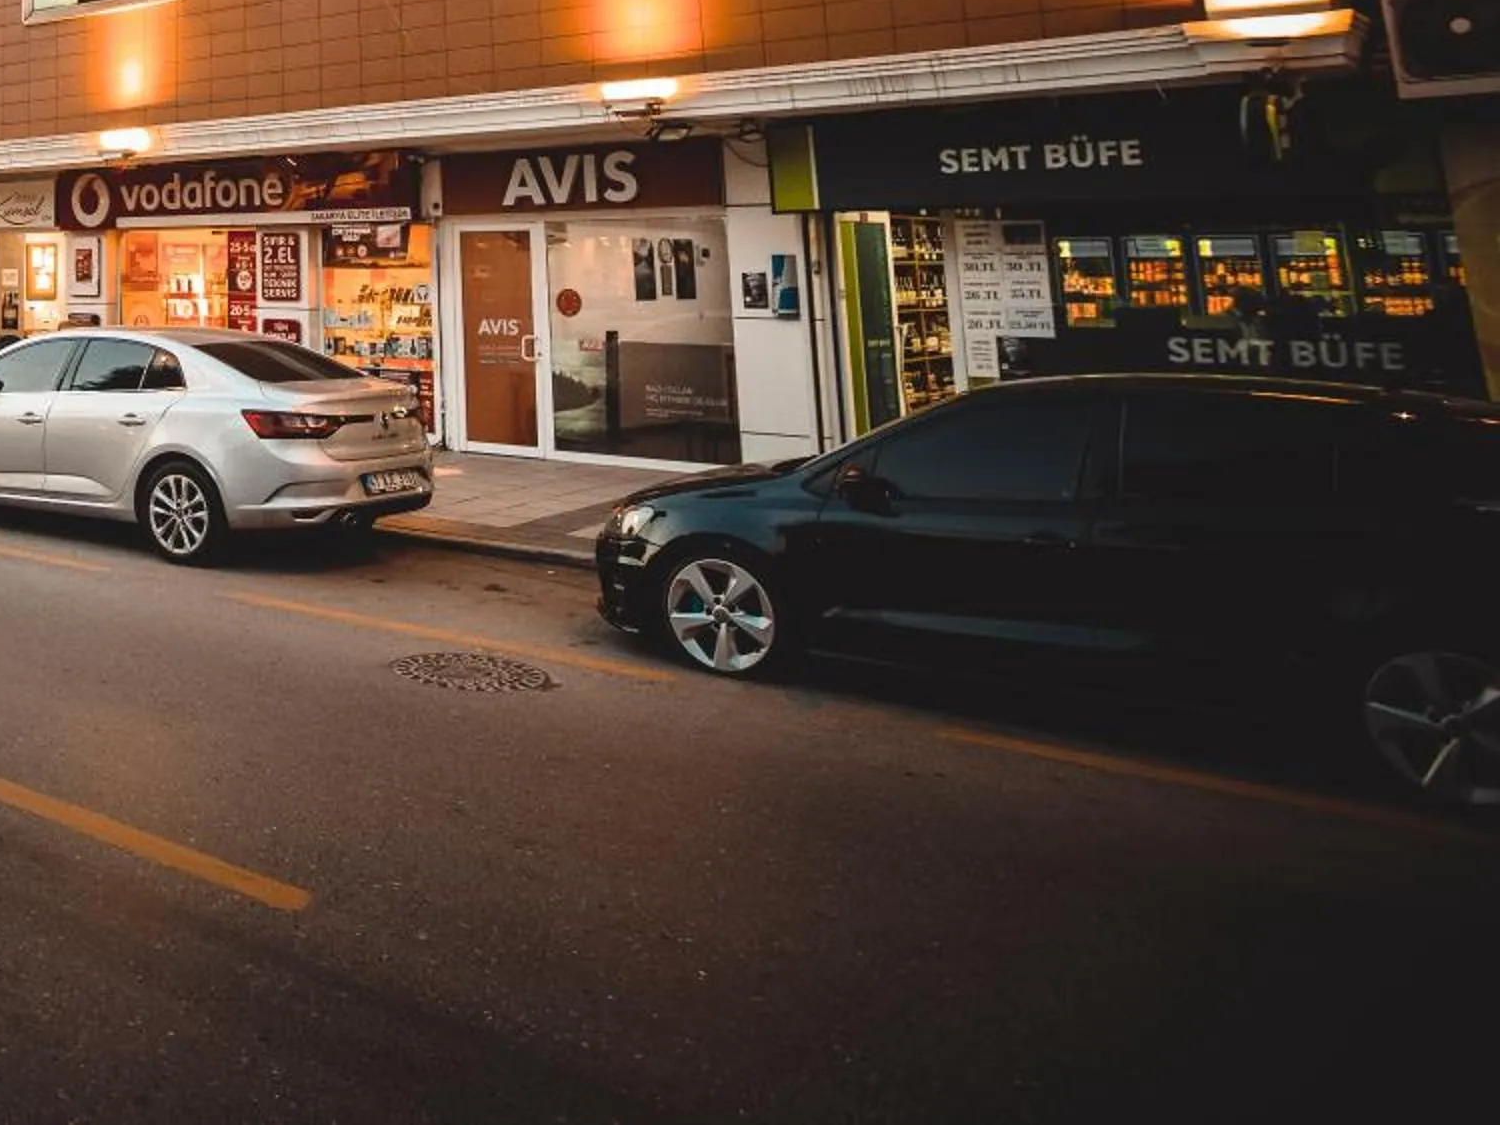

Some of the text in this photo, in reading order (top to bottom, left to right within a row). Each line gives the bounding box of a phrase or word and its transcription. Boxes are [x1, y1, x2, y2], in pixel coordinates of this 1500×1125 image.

[940, 135, 1143, 174] SEMT BÜFE
[120, 171, 284, 212] vodafone
[502, 150, 640, 207] AVIS
[263, 247, 296, 264] 2.EL
[478, 318, 520, 335] AVIS
[1167, 333, 1405, 370] SEMT BÜFE
